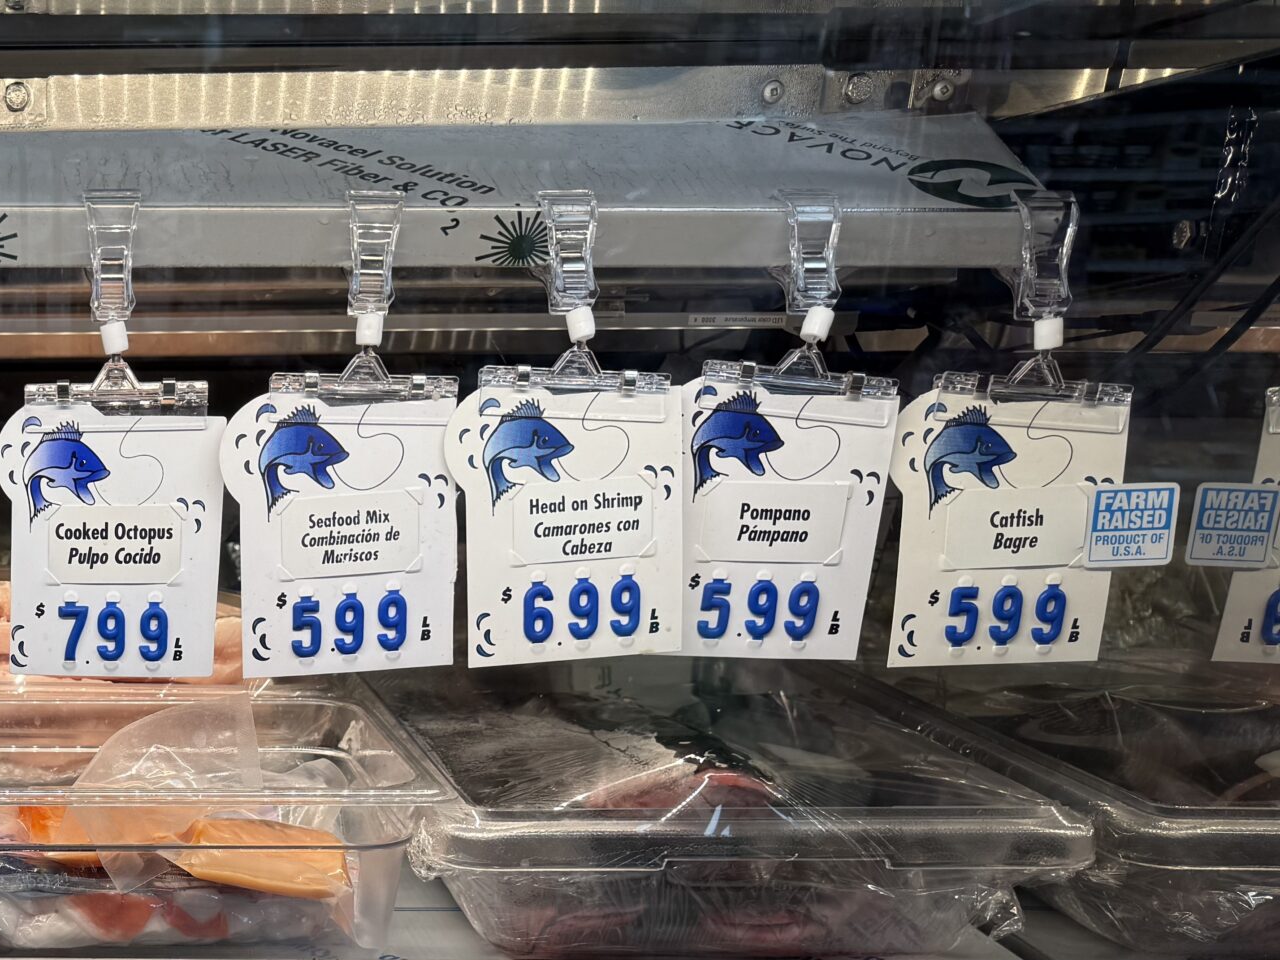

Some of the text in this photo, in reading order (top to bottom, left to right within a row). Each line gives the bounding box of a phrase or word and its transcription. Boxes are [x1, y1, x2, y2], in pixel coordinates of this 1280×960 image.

[228, 132, 322, 163] LASER
[317, 159, 394, 185] Fiber
[377, 155, 496, 195] Solution
[529, 492, 643, 515] Head on Shrimp
[1098, 489, 1169, 511] FARM
[308, 509, 390, 529] Seafood Mix
[739, 503, 811, 525] Pompano
[990, 508, 1044, 528] Catfish
[1096, 510, 1167, 530] RAISED
[55, 522, 173, 545] Cooked Octopus
[301, 526, 400, 548] Combinación de
[534, 518, 640, 538] Camarones con
[737, 524, 809, 547] Pámpano
[561, 538, 613, 556] Cabeza
[993, 532, 1038, 554] Bagre
[1095, 533, 1165, 546] PRODUCT OF
[68, 546, 161, 569] Pulpo Cocido
[1111, 545, 1146, 558] U.S.A.
